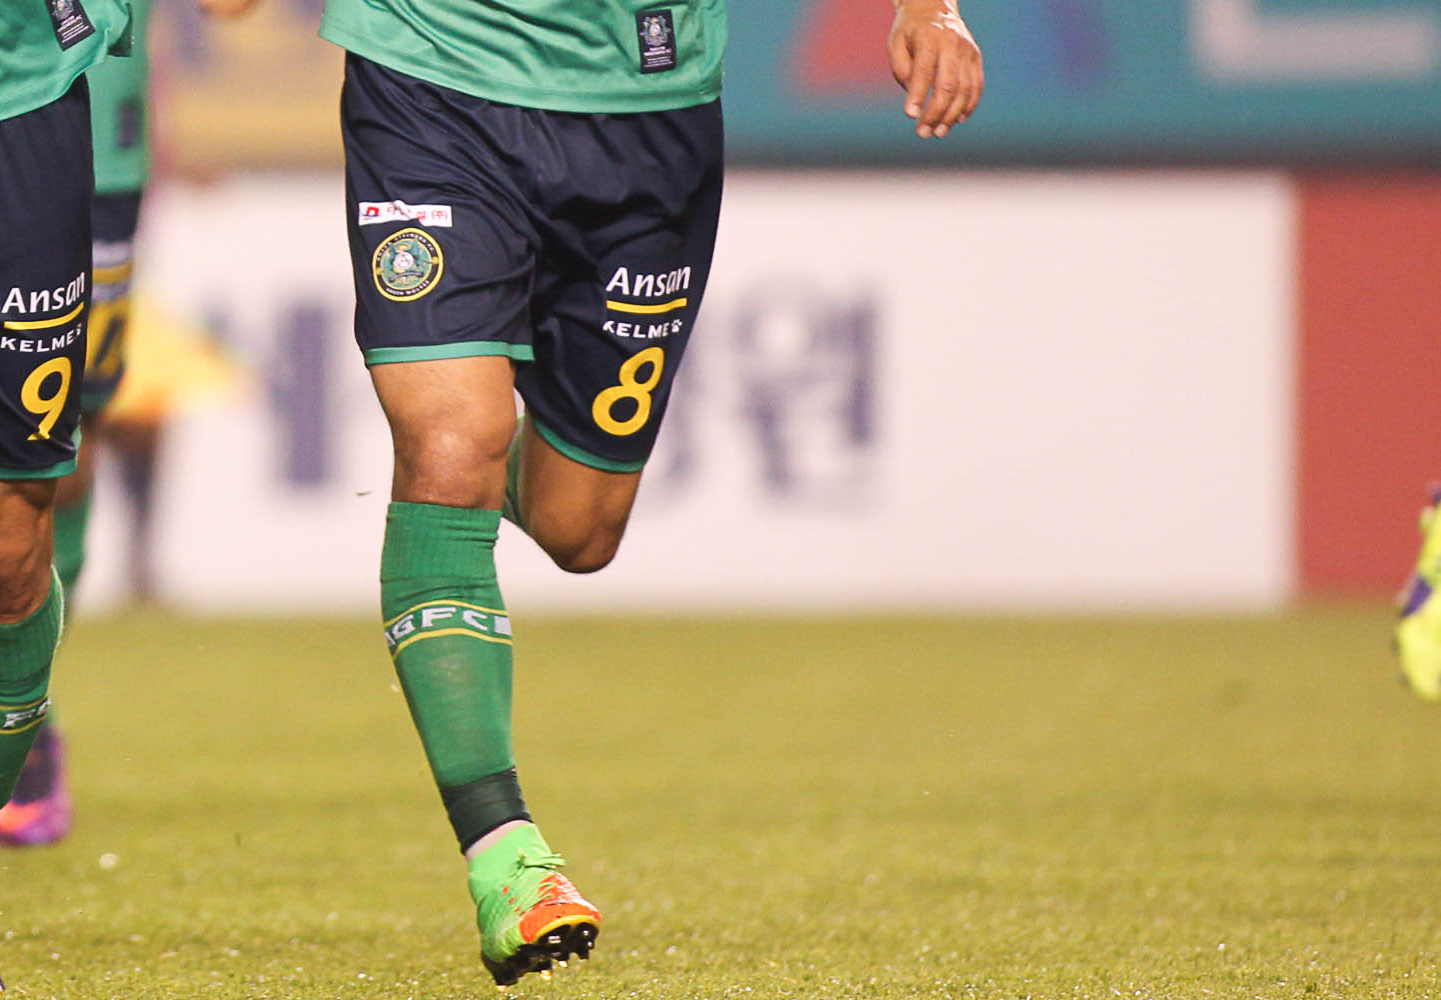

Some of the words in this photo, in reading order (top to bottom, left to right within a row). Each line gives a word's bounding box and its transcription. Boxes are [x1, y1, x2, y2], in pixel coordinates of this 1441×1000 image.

[1, 271, 86, 315] Ansan
[605, 266, 692, 298] Ansan
[0, 328, 75, 353] KELME
[603, 319, 670, 339] KELME
[20, 355, 73, 442] 9
[591, 345, 666, 437] 8
